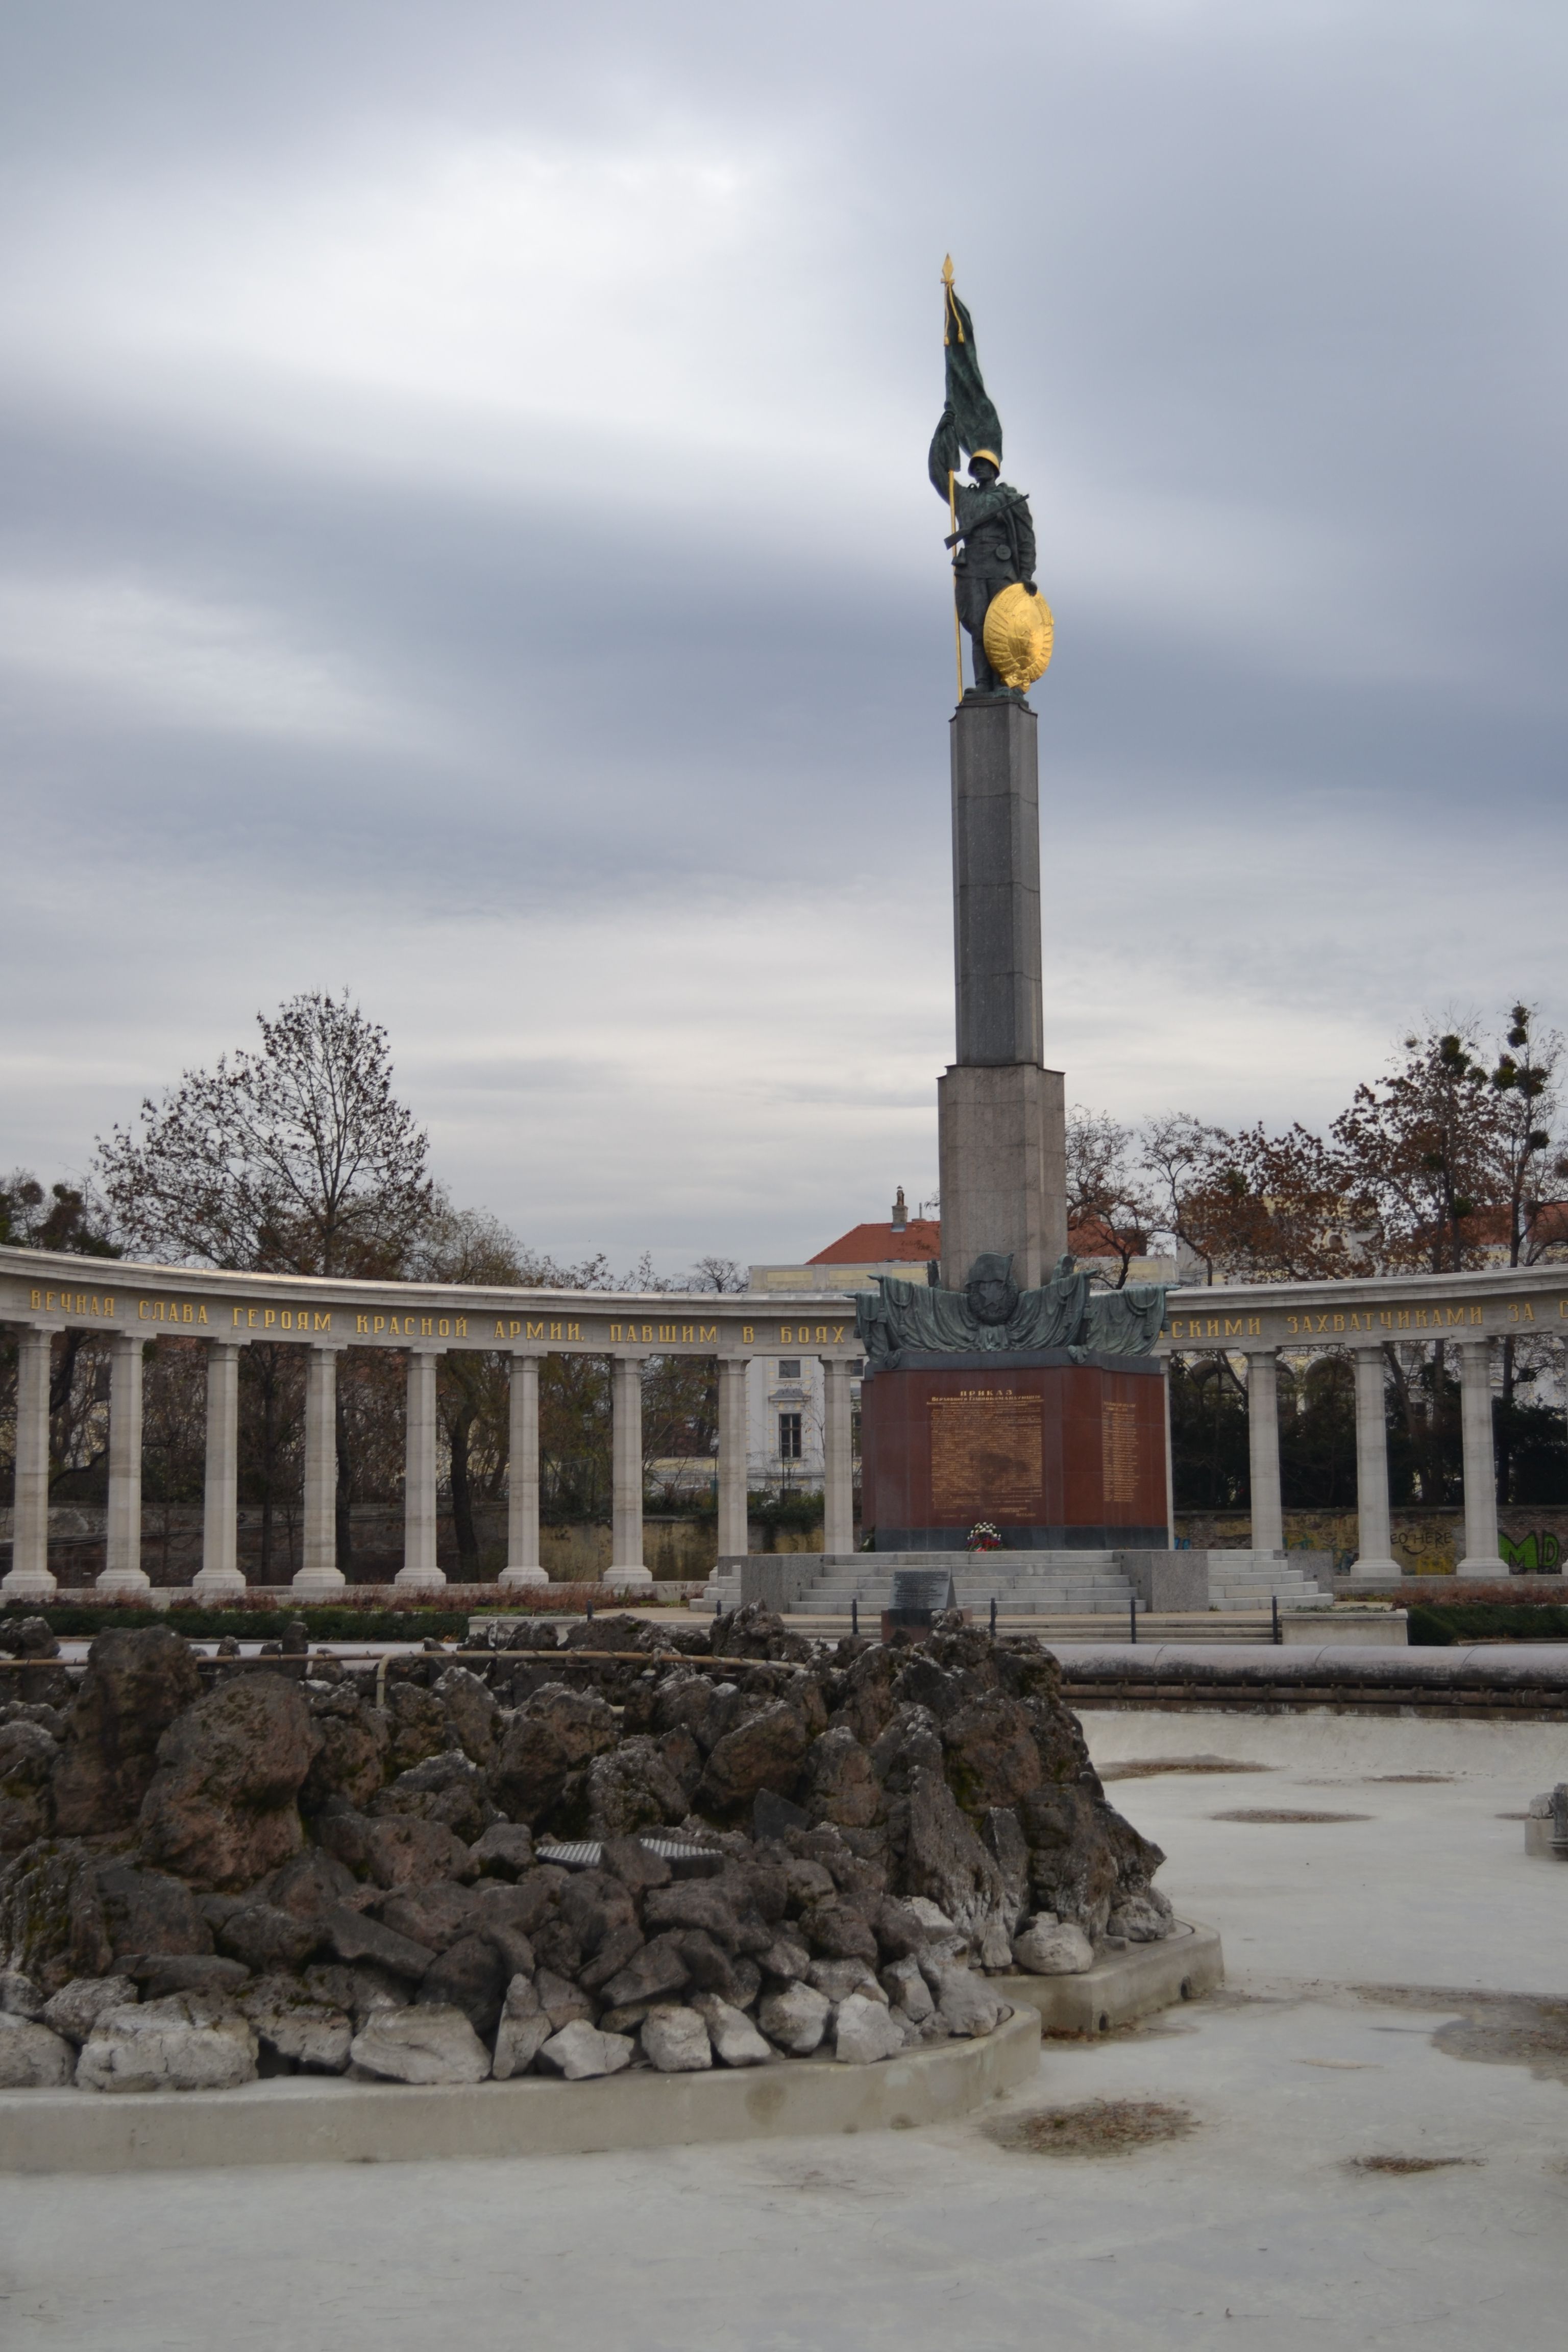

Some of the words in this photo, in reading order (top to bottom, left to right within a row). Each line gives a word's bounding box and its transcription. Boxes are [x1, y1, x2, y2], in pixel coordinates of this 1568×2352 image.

[30, 1289, 115, 1317] ВЕЧНАЯ
[138, 1300, 208, 1324] СЛАВА
[232, 1307, 332, 1331] ГЕРОЯМ
[356, 1315, 468, 1337] КРАСНОЙ
[494, 1320, 585, 1342] АРМИИ,
[610, 1325, 718, 1343] ПАВШИМ
[742, 1326, 754, 1343] В
[780, 1326, 845, 1344] БОЯХ
[1159, 1317, 1261, 1339] СКИМИ
[1287, 1306, 1483, 1335] ЗАХВАТЧИКАМИ
[1508, 1303, 1535, 1322] ЗА
[1414, 1531, 1453, 1549] HERE
